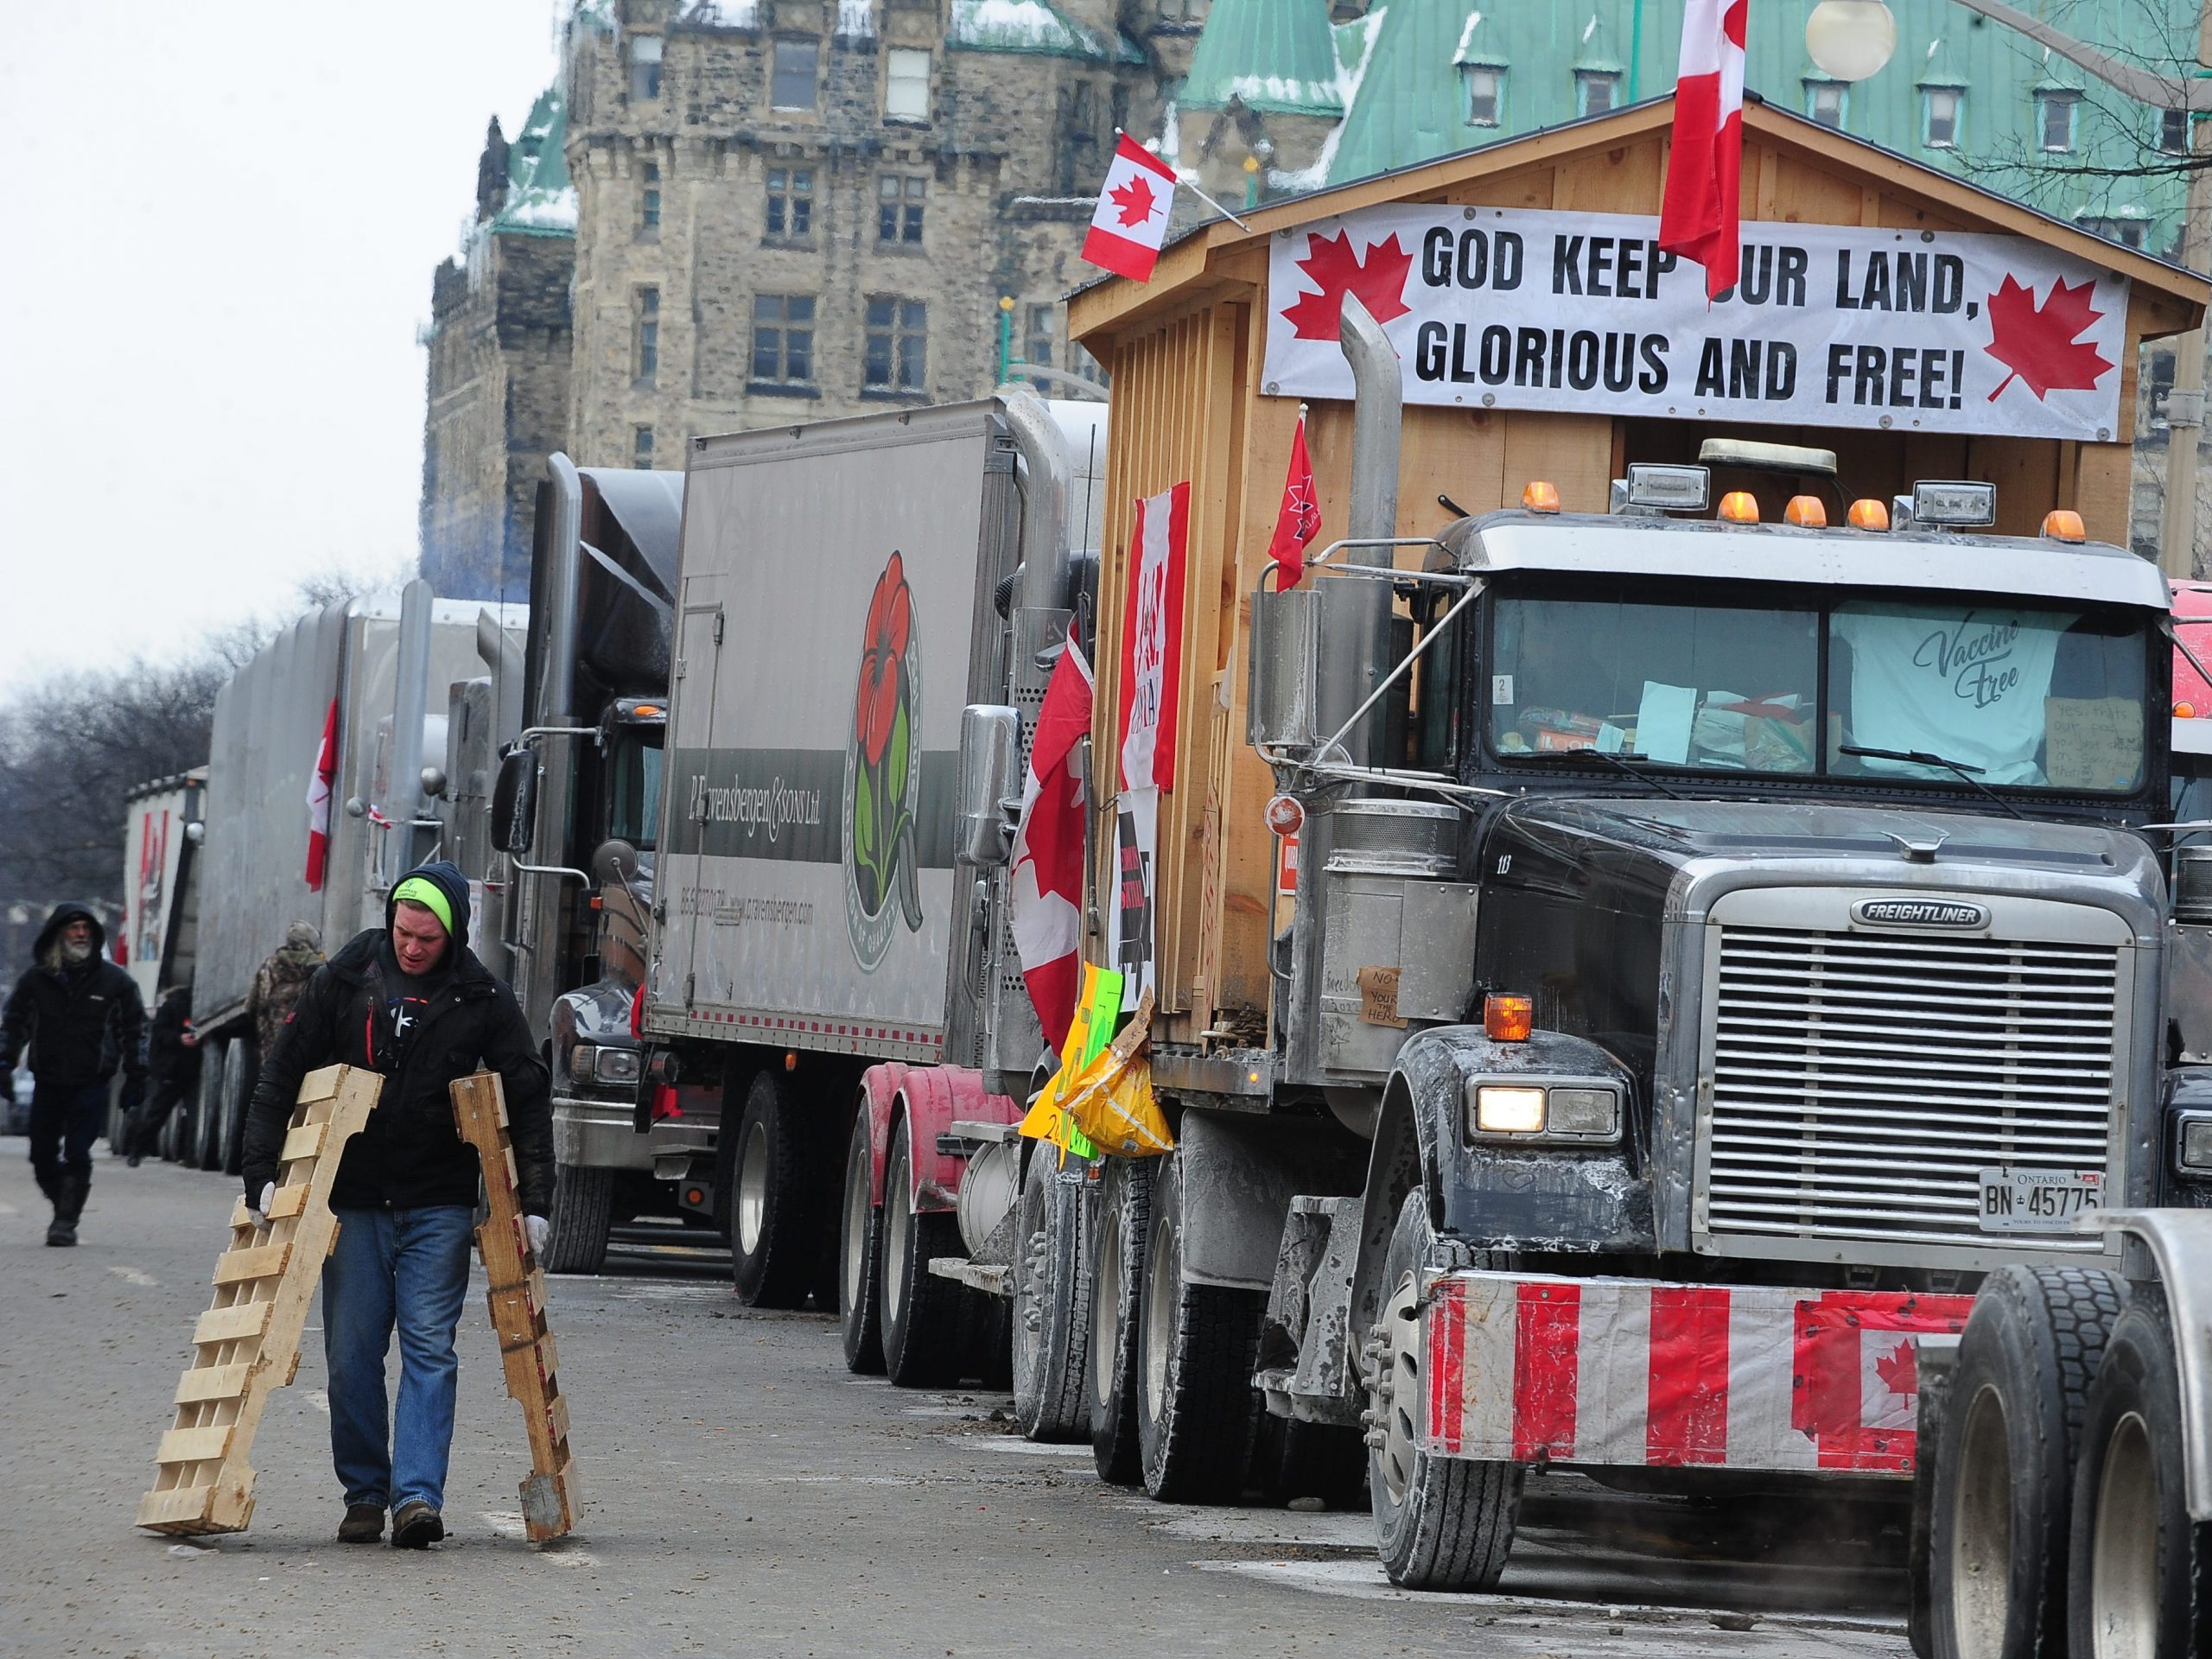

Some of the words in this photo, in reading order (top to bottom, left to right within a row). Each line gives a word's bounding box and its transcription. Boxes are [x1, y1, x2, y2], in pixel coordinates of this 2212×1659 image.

[1421, 226, 1524, 291] GOD
[1553, 234, 1679, 299] KEEP
[1705, 244, 1809, 307] UR
[1835, 249, 1980, 321] LAND,
[1415, 321, 1669, 394] GLORIOUS
[1694, 337, 1797, 401] AND
[1826, 343, 1965, 410] FREE!
[1913, 610, 2019, 677] Vaccine
[1955, 648, 2019, 709] Free
[1866, 905, 1977, 922] FREIGHTLINER
[1371, 992, 1397, 1005] YOUR
[1986, 1185, 2012, 1215] BN
[2018, 1174, 2066, 1185] ONTARIO
